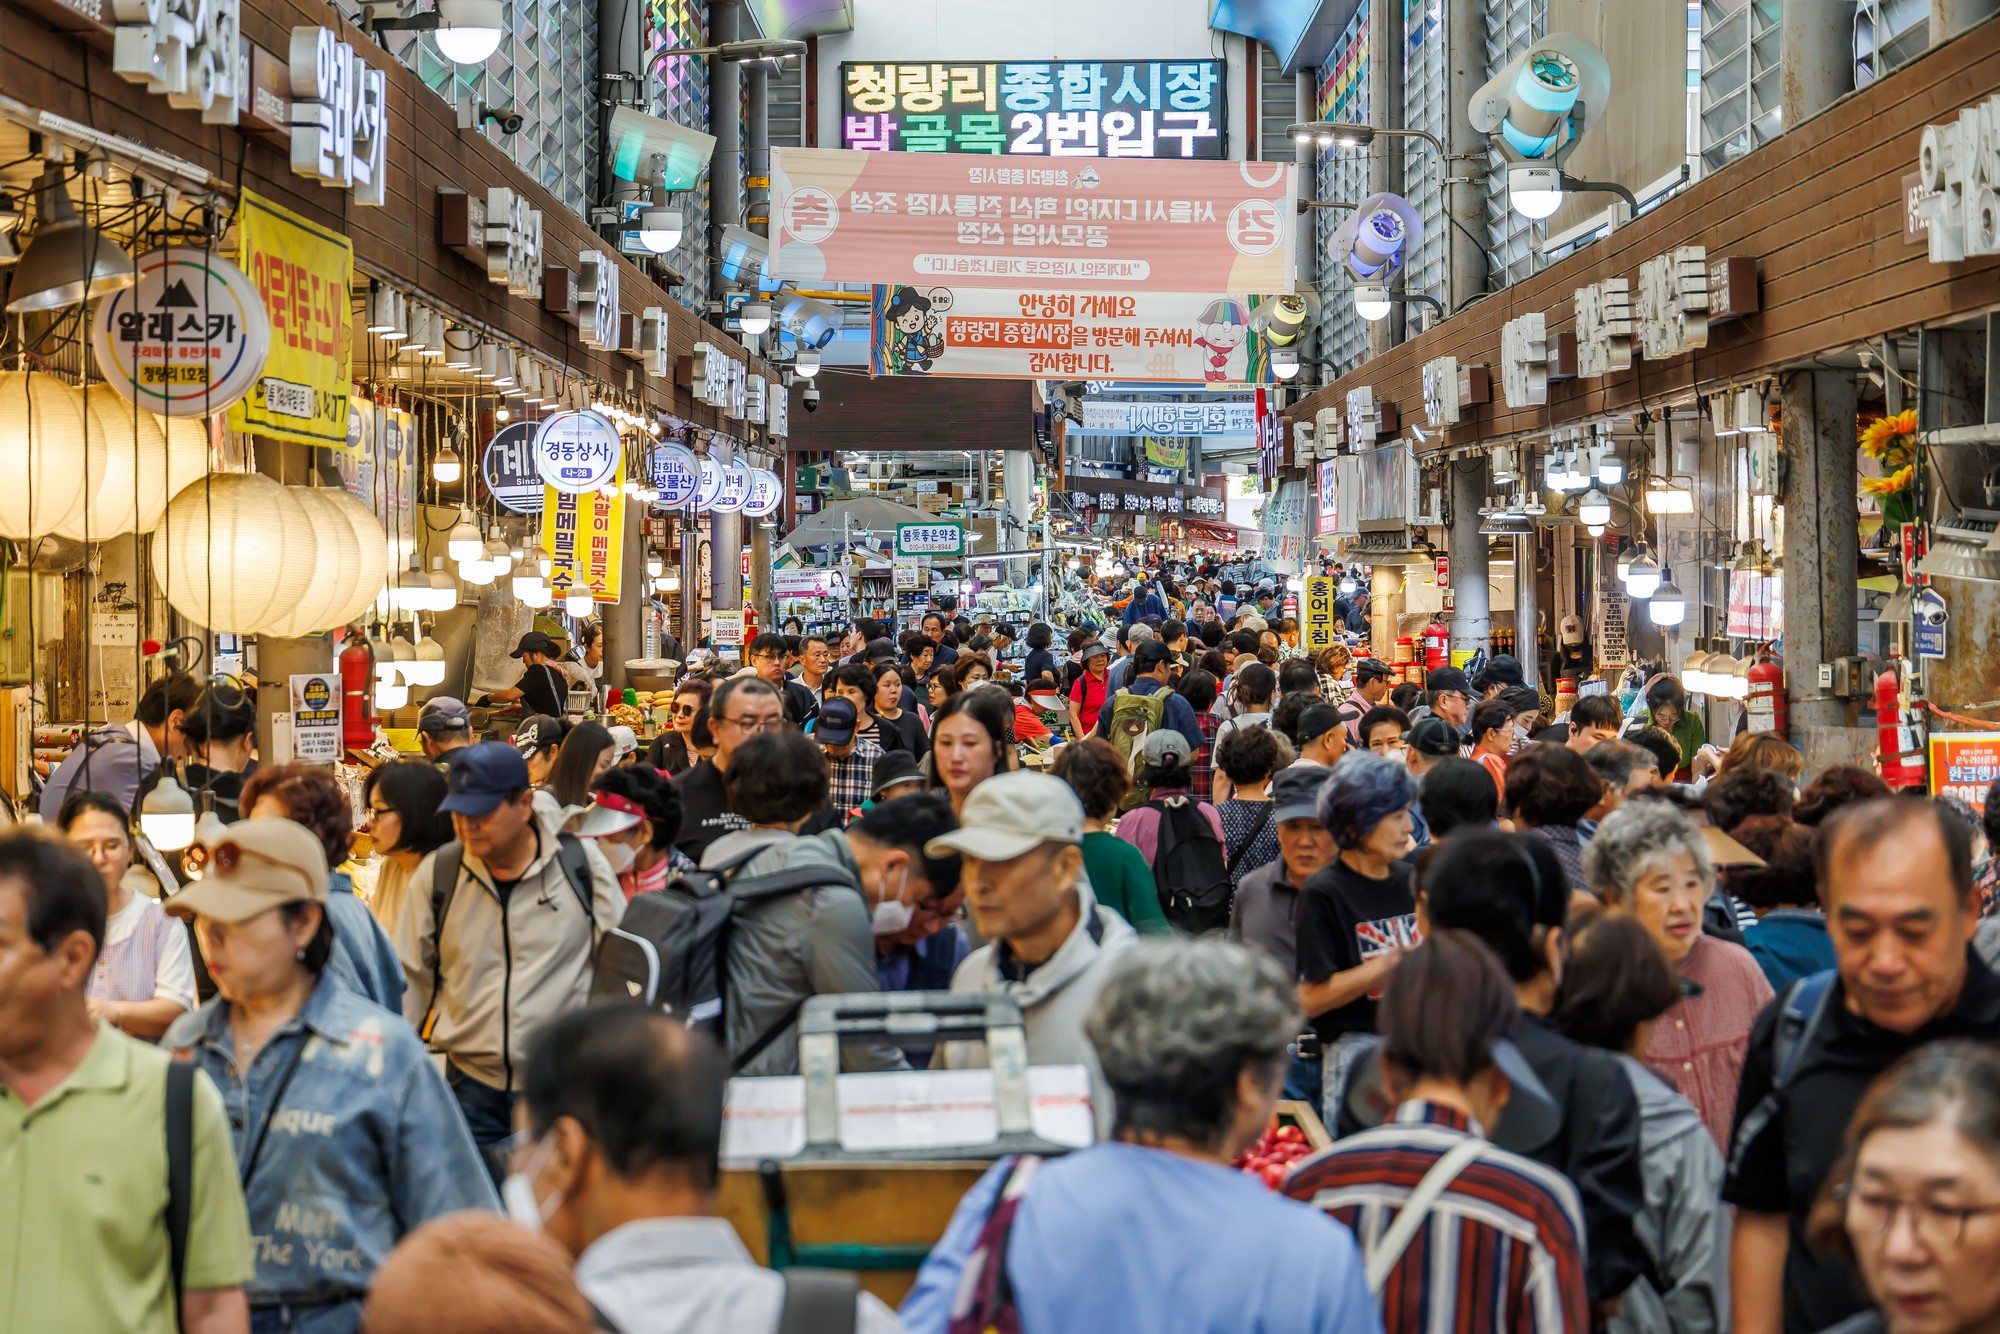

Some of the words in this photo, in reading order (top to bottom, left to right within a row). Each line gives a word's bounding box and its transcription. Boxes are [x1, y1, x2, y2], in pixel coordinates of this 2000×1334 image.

[1018, 293, 1075, 318] 안녕히
[1080, 295, 1137, 318] 가세요
[950, 319, 1000, 342] 청량리
[1003, 321, 1088, 348] 종합시장을
[1092, 326, 1140, 348] 방문해
[1143, 327, 1193, 348] 주셔서
[1028, 352, 1115, 374] 감사합니다.
[143, 366, 178, 382] 청량리
[180, 366, 208, 383] 1호점
[545, 441, 609, 461] 경동상사
[566, 468, 588, 477] 나-28
[648, 474, 693, 489] 성물산
[590, 536, 608, 593] 메밀국수
[1310, 581, 1331, 645] 홍어무침
